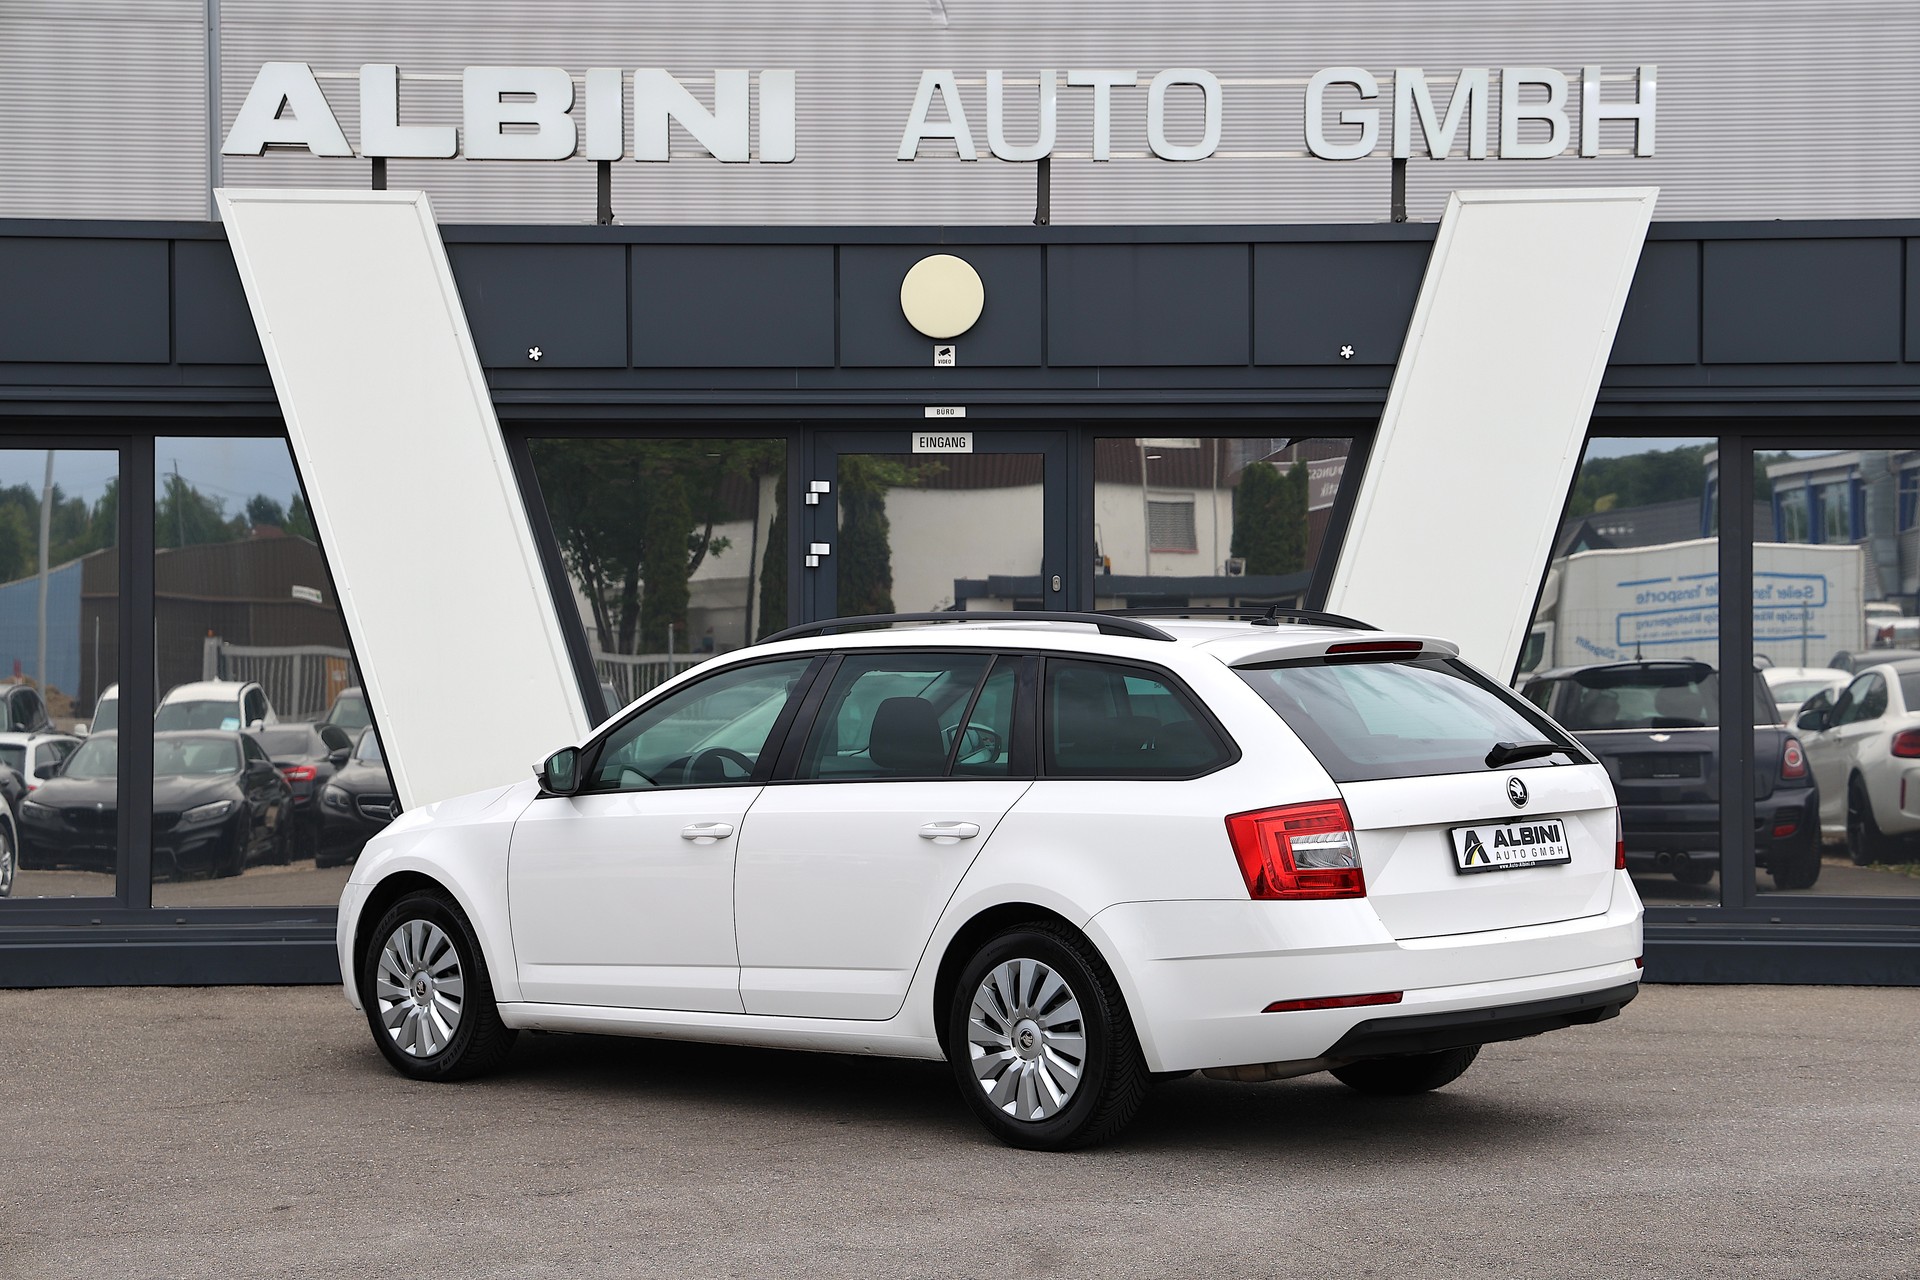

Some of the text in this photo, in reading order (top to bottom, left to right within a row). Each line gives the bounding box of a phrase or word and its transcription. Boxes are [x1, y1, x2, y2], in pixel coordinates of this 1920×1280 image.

[221, 62, 1657, 163] ALBINI AUTO GMBH
[919, 436, 966, 448] EINGANG
[1494, 824, 1561, 848] ALBINI
[1496, 846, 1564, 861] AUTO GMBH
